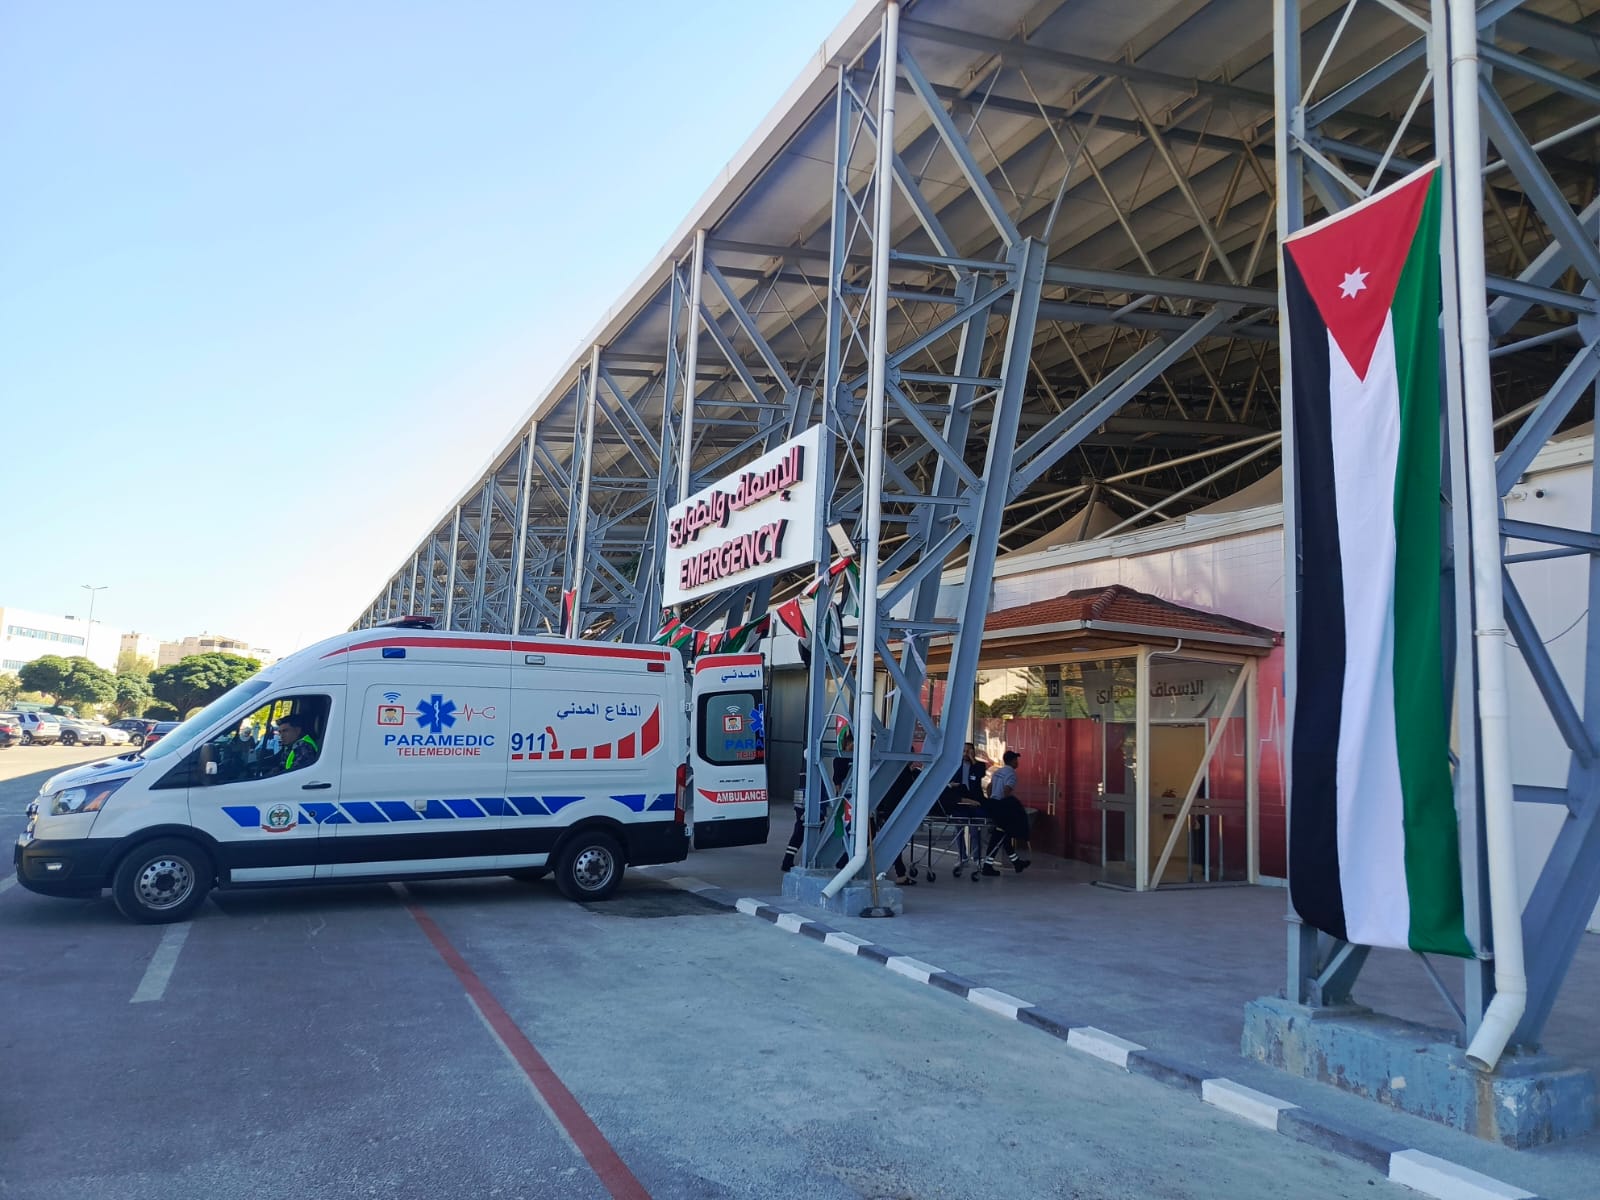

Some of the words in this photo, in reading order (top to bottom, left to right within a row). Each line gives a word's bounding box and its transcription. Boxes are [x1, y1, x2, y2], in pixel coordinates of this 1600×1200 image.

[680, 518, 789, 591] EMERGENCY
[721, 669, 760, 683] المدني
[556, 702, 600, 720] المدني
[604, 702, 642, 721] الدفاع
[384, 734, 495, 747] PARAMEDIC
[511, 732, 546, 751] 911
[396, 746, 481, 757] TELEMEDICINE
[716, 789, 767, 802] AMBULANCE
